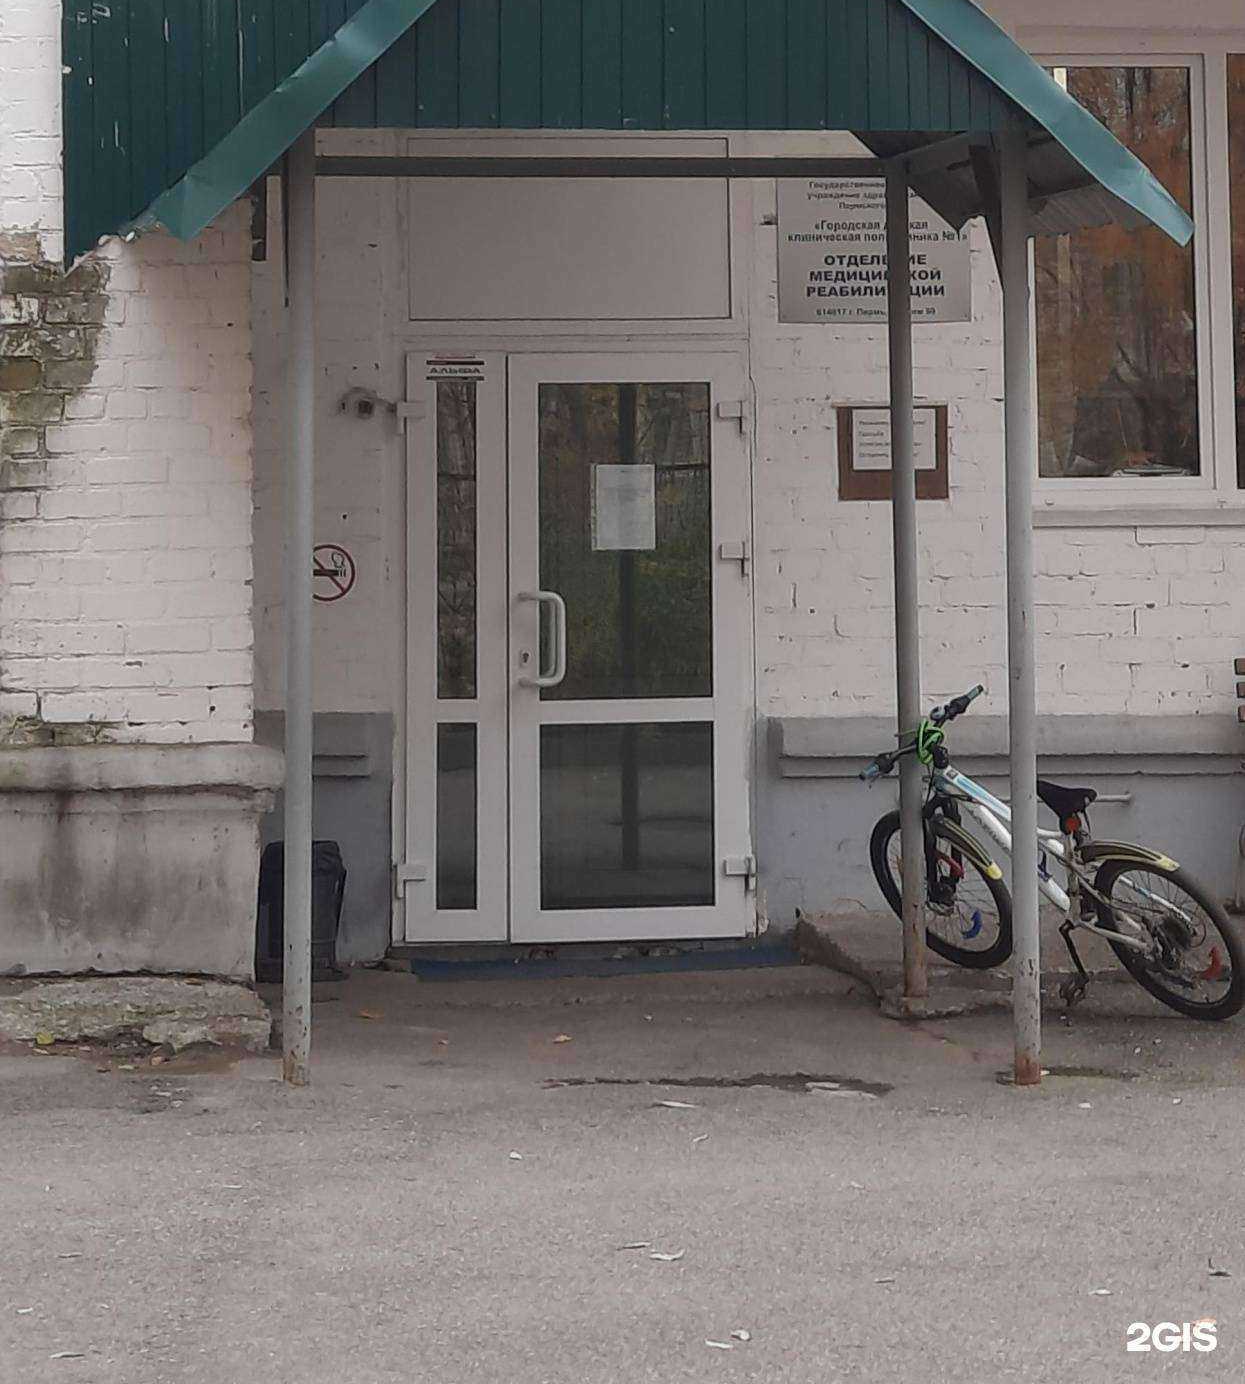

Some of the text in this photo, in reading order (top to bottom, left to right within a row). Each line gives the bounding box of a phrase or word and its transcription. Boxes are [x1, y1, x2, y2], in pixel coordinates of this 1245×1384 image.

[787, 233, 861, 242] клиническая
[864, 232, 939, 242] полника
[824, 254, 928, 268] ОТДЕЛИЕ
[809, 267, 942, 284] МЕДИЦИКОЙ
[806, 285, 945, 299] РЕАБИЛИЦИИ
